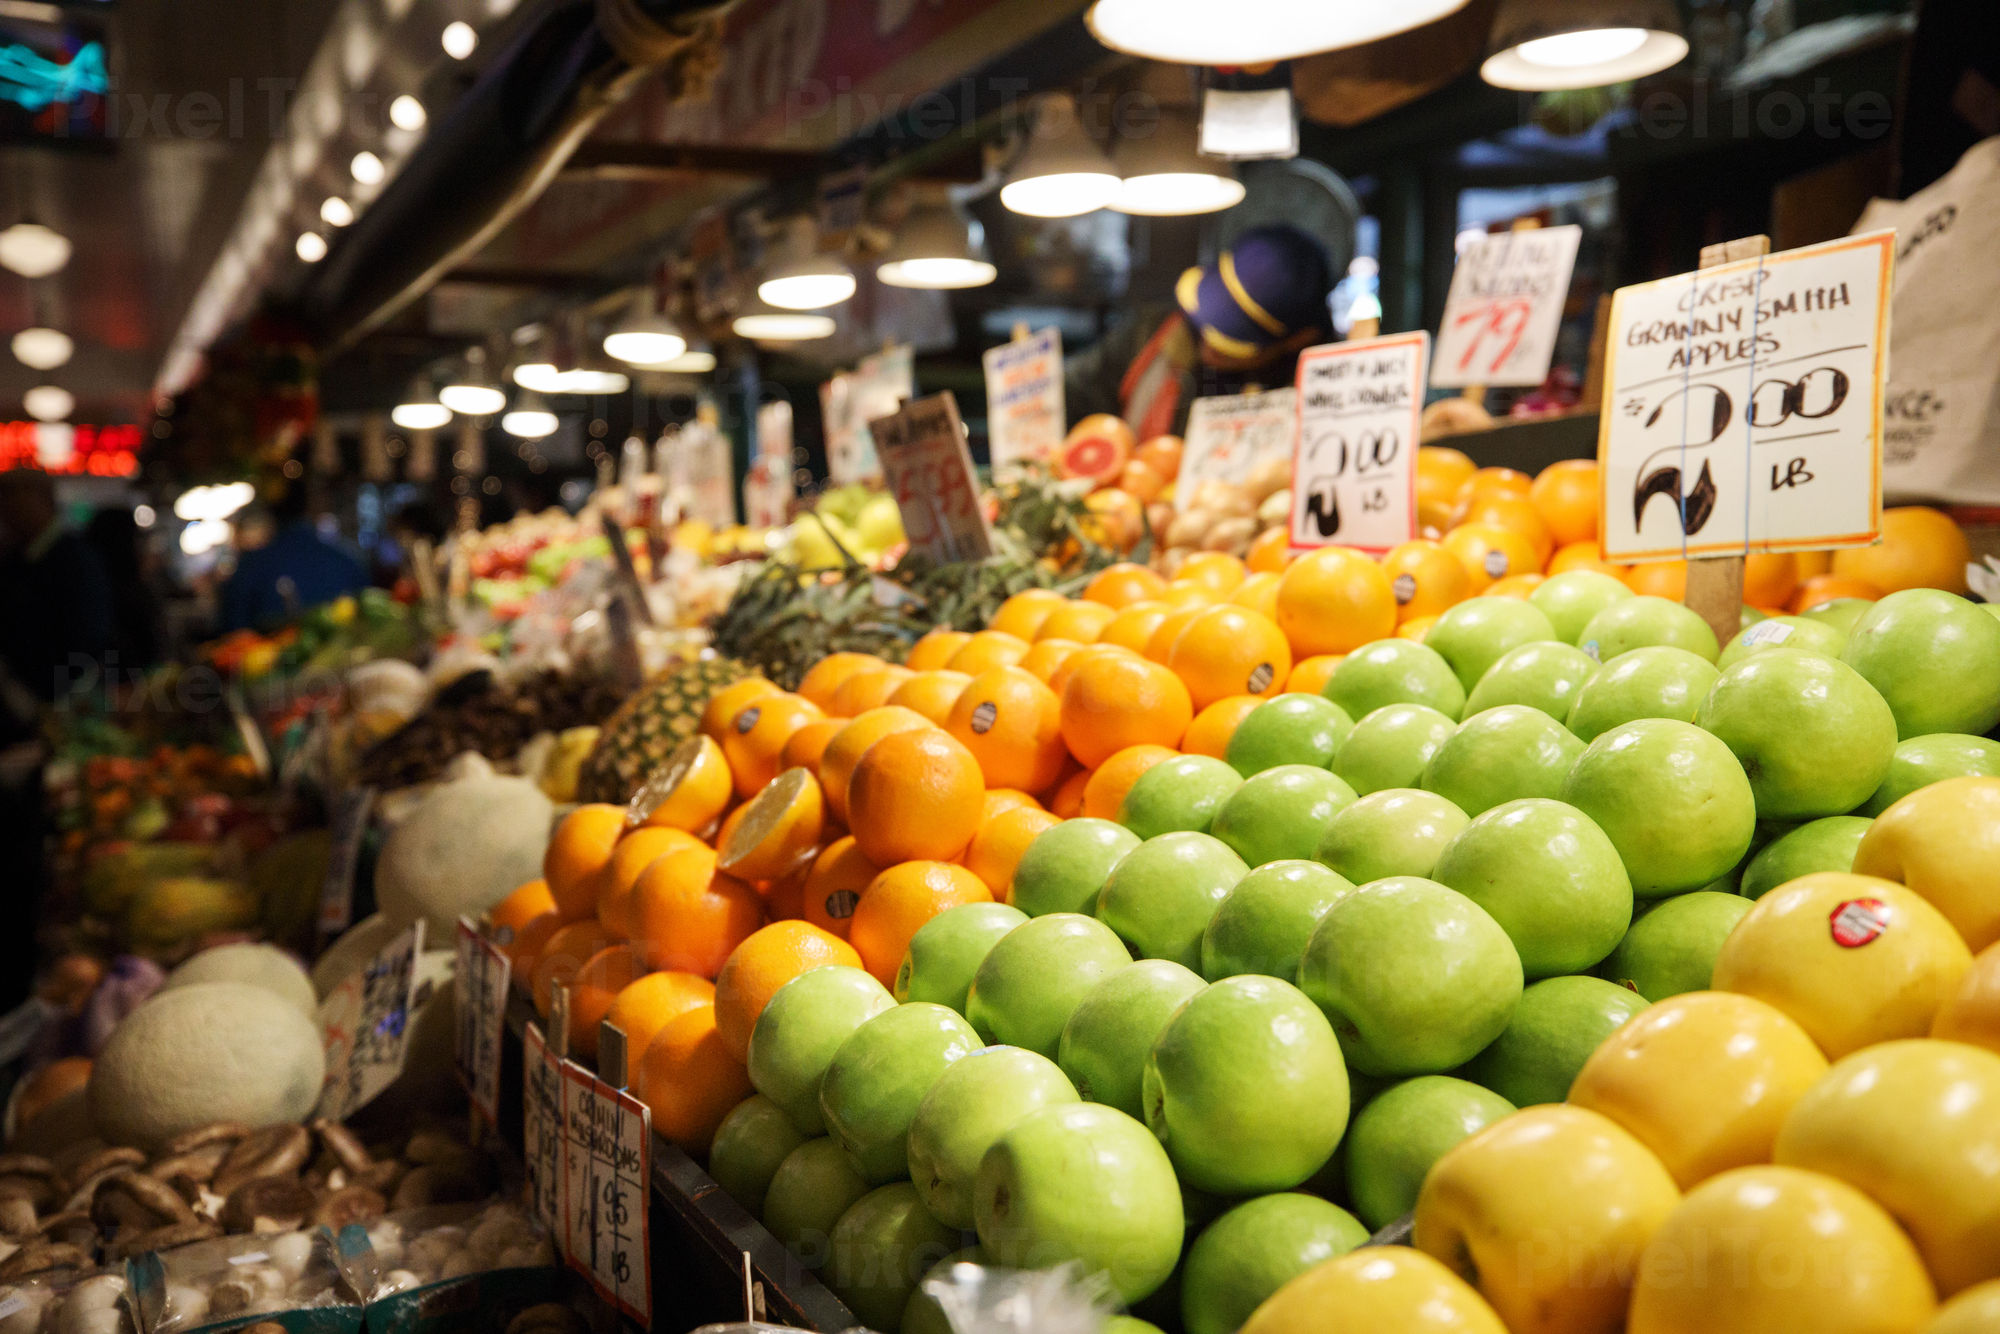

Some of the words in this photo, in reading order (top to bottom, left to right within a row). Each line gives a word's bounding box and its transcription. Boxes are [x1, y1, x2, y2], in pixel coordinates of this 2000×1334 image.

[1677, 269, 1771, 313] CRISP
[1626, 308, 1743, 347] GRANNY
[1754, 282, 1851, 325] SMITH
[1667, 332, 1781, 371] APPLES
[1770, 456, 1815, 491] LB
